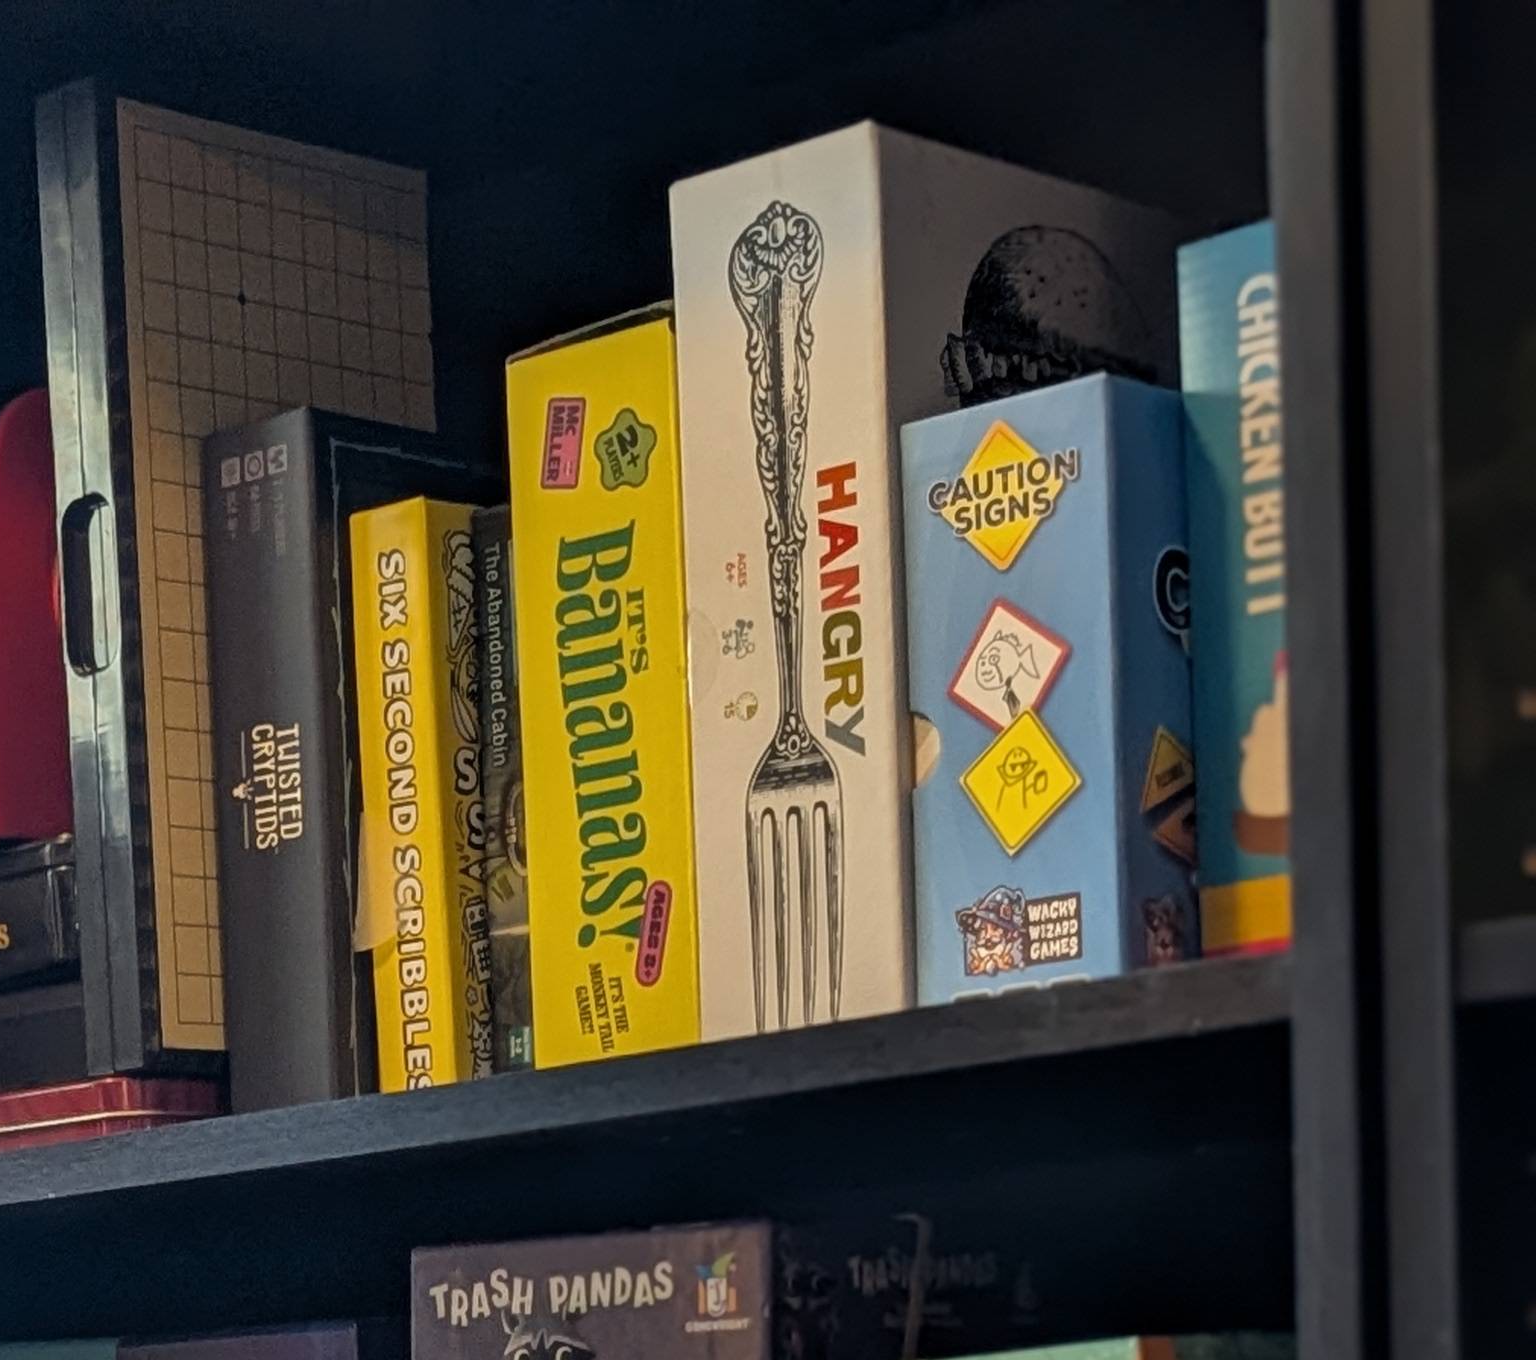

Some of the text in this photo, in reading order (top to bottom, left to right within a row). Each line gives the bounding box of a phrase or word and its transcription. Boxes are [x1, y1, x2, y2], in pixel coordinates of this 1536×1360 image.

[603, 437, 626, 482] PLAYERS
[617, 424, 642, 470] 2+
[928, 449, 1080, 515] CAUTION
[953, 486, 1055, 538] SIGNS
[378, 547, 408, 630] SIX
[815, 462, 866, 758] HANGRY
[484, 541, 507, 768] The Abandoned Cabin
[624, 587, 651, 674] IT'S
[382, 639, 417, 836] SECOND
[251, 721, 278, 850] CRYPTIDS
[275, 721, 302, 839] TWISTED
[644, 891, 667, 944] AGES
[1028, 896, 1078, 923] WACKY
[1029, 914, 1079, 941] WIZARD
[1030, 932, 1079, 962] GAMES
[589, 963, 610, 1021] MONKEY
[429, 1260, 674, 1328] TRASH PANDAS
